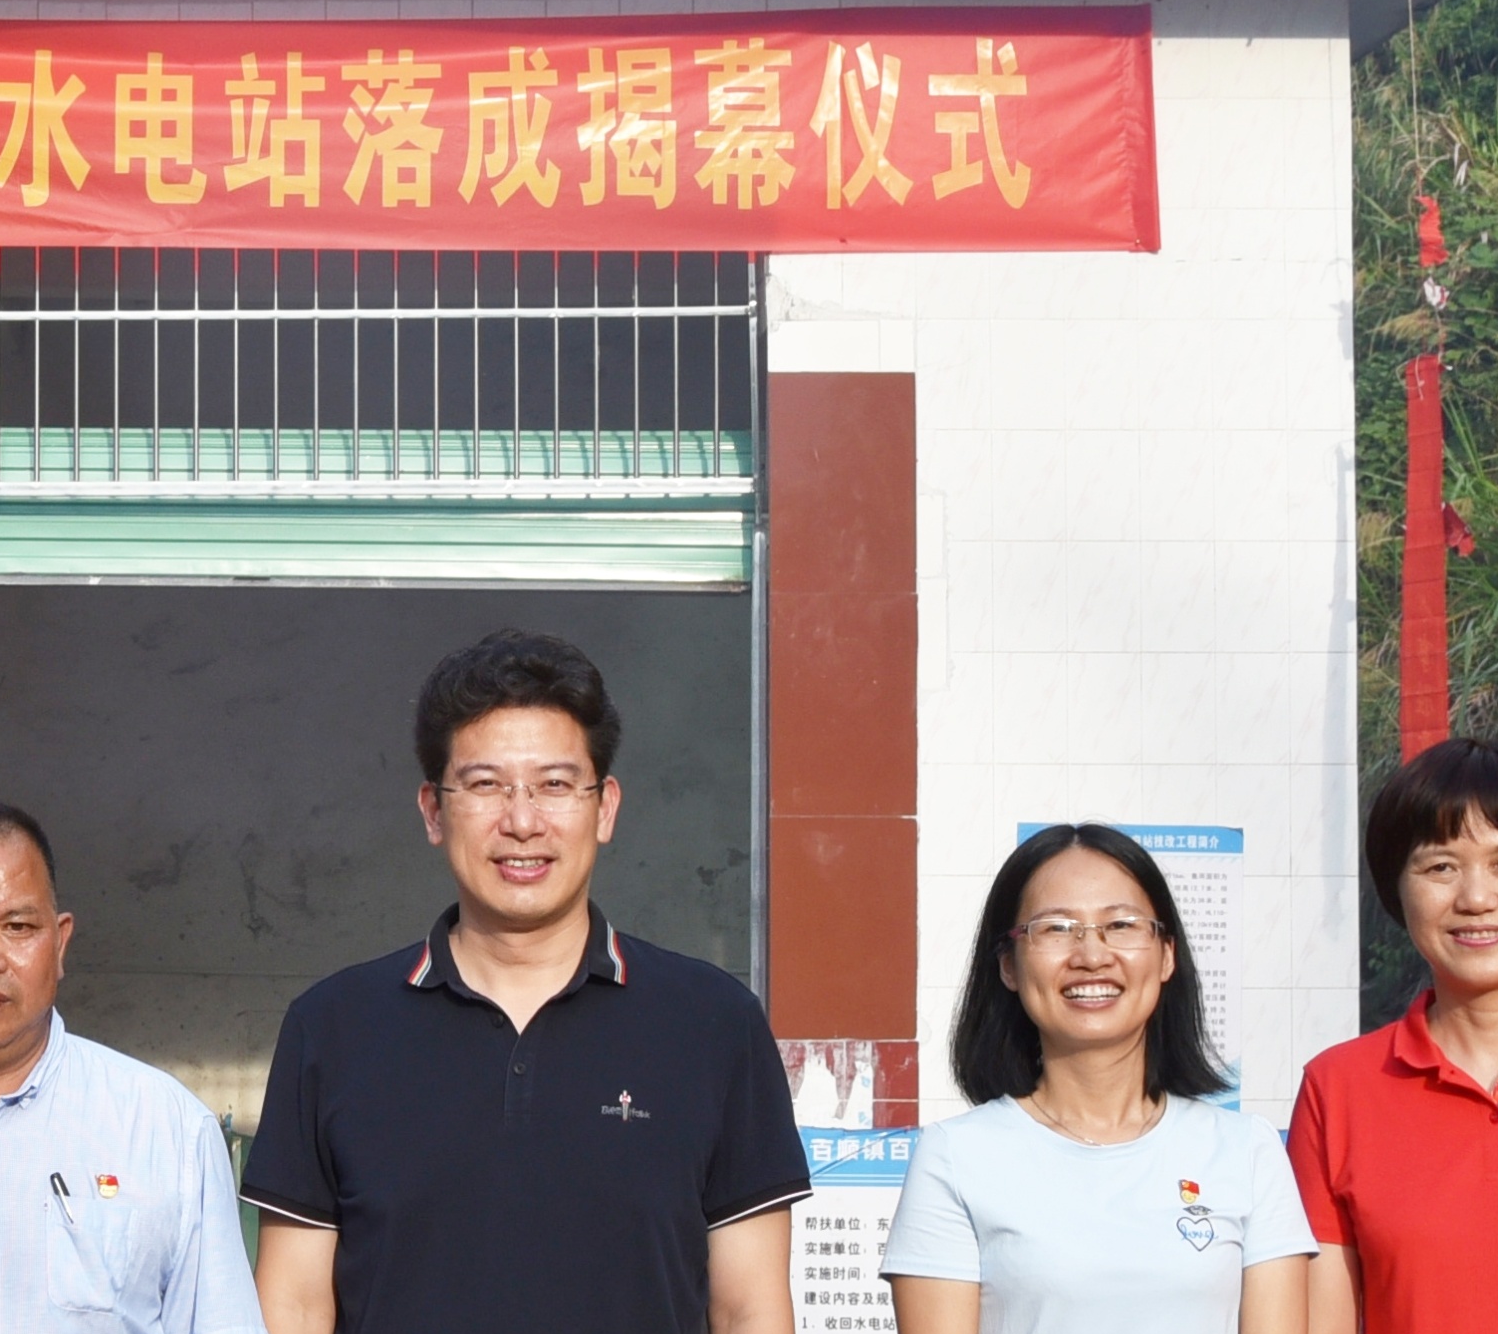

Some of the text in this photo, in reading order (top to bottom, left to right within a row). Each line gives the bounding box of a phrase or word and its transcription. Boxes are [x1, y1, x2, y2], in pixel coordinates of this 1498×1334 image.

[809, 1136, 918, 1162] 百顺镇百
[804, 1291, 894, 1306] 建设内容及规
